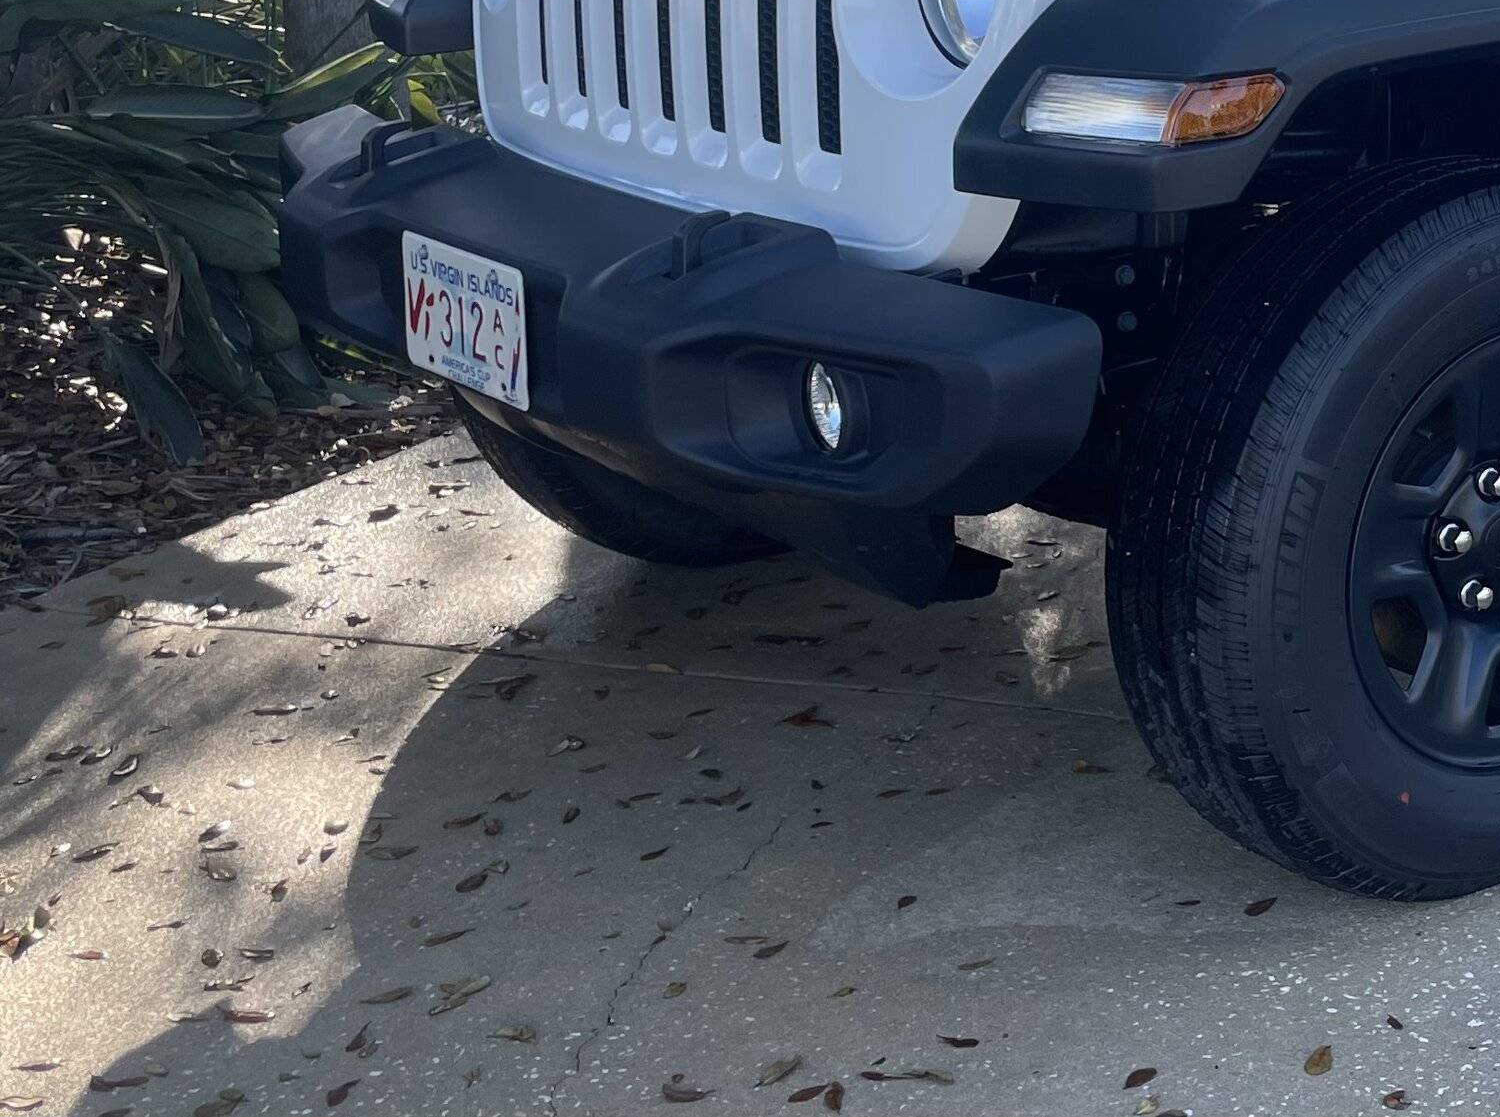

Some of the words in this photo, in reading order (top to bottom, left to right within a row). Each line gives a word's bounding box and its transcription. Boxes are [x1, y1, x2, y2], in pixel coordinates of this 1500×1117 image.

[430, 258, 464, 288] VIRGIN
[467, 271, 514, 307] ISLANDS
[439, 290, 487, 363] 312
